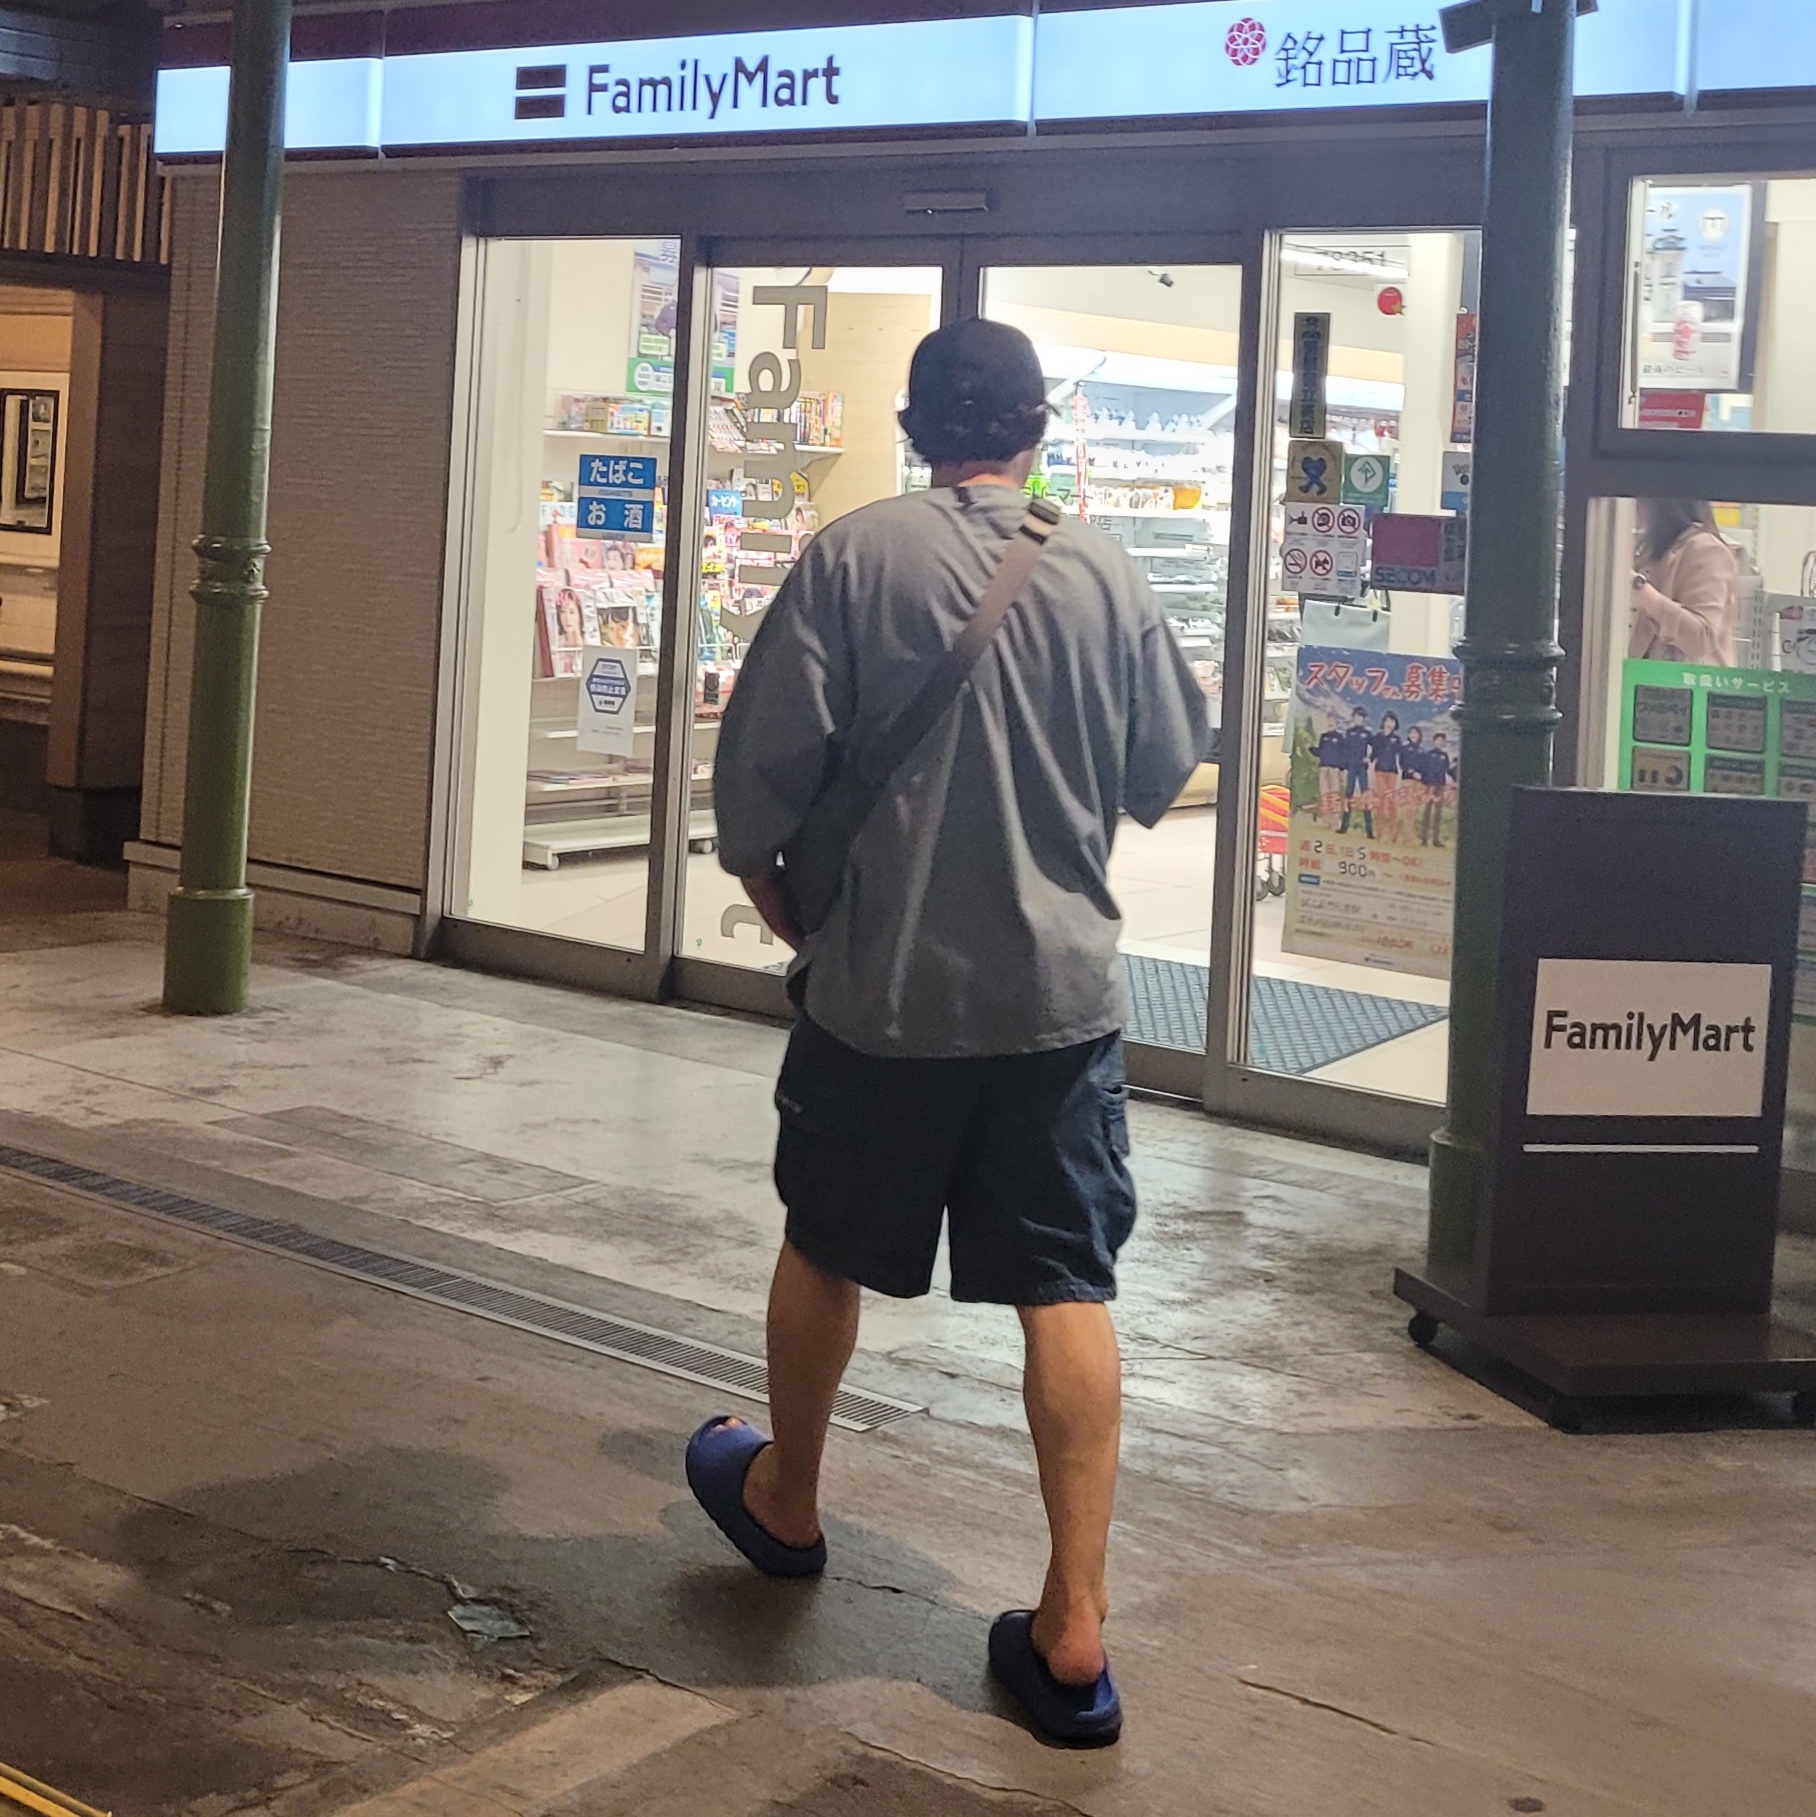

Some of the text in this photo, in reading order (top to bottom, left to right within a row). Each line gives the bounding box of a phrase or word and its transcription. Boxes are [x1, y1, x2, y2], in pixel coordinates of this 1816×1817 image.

[1273, 24, 1438, 88] 銘品蔵
[586, 53, 841, 120] FamilyMart
[589, 458, 644, 485] たばこ
[587, 500, 644, 529] お酒
[1375, 566, 1436, 585] SECOM
[1682, 671, 1791, 694] 取扱いサービス
[1543, 1010, 1757, 1061] FamilyMart
